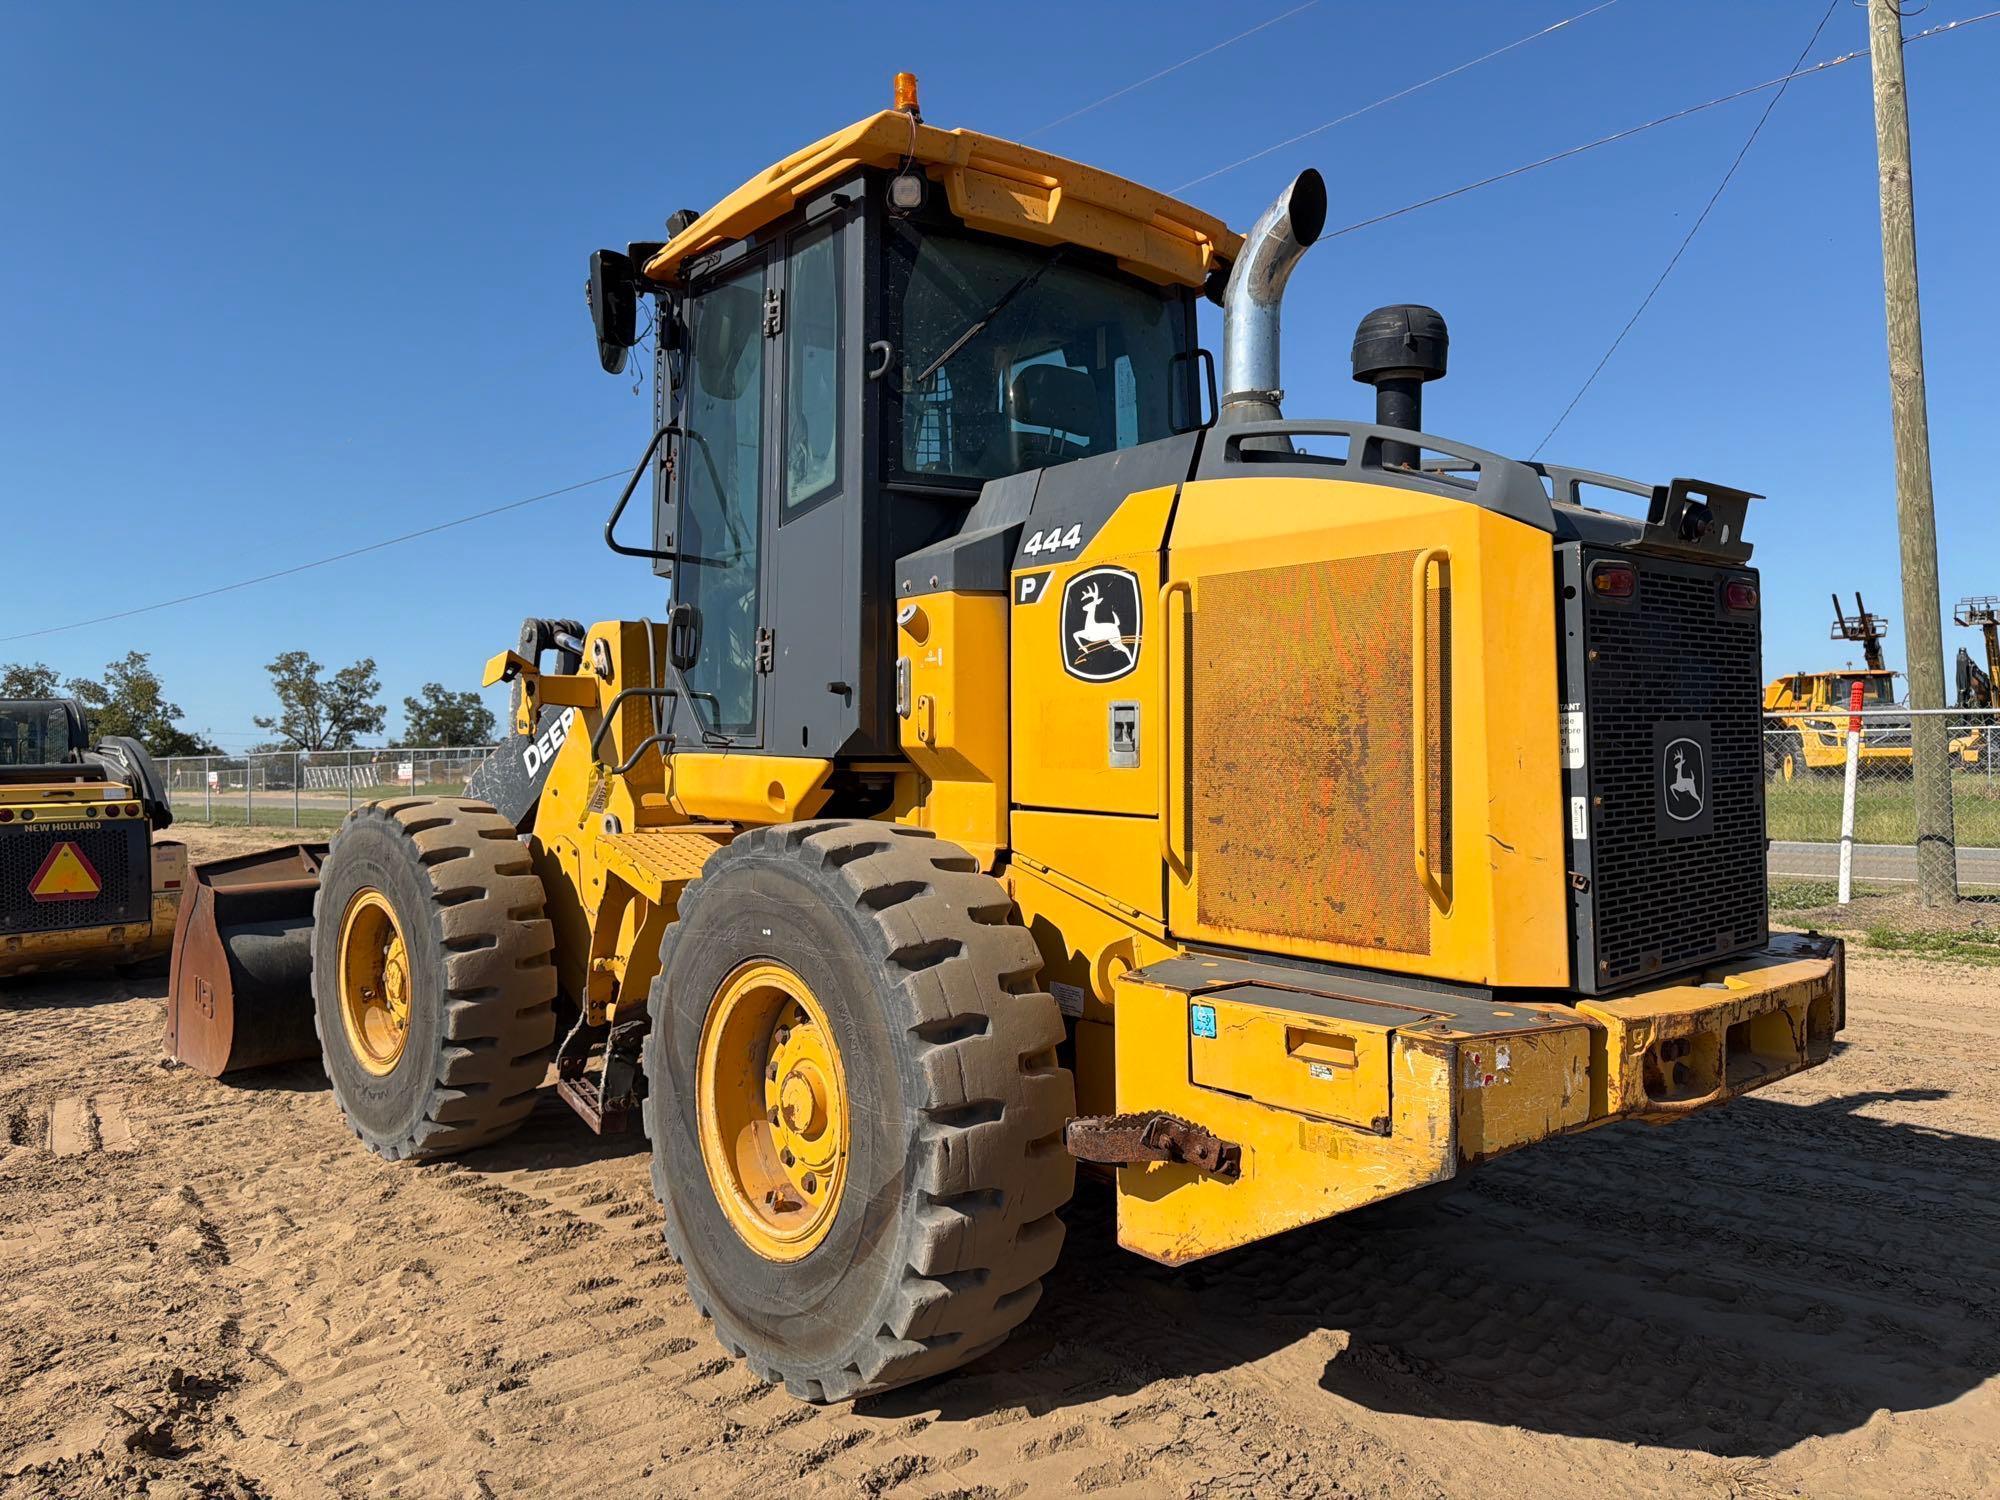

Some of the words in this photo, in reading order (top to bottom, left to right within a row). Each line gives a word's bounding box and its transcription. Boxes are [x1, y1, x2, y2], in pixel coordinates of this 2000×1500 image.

[1023, 523, 1082, 556] 444
[1020, 577, 1037, 602] P
[24, 823, 50, 833] NEW
[52, 821, 101, 831] HOLLAND
